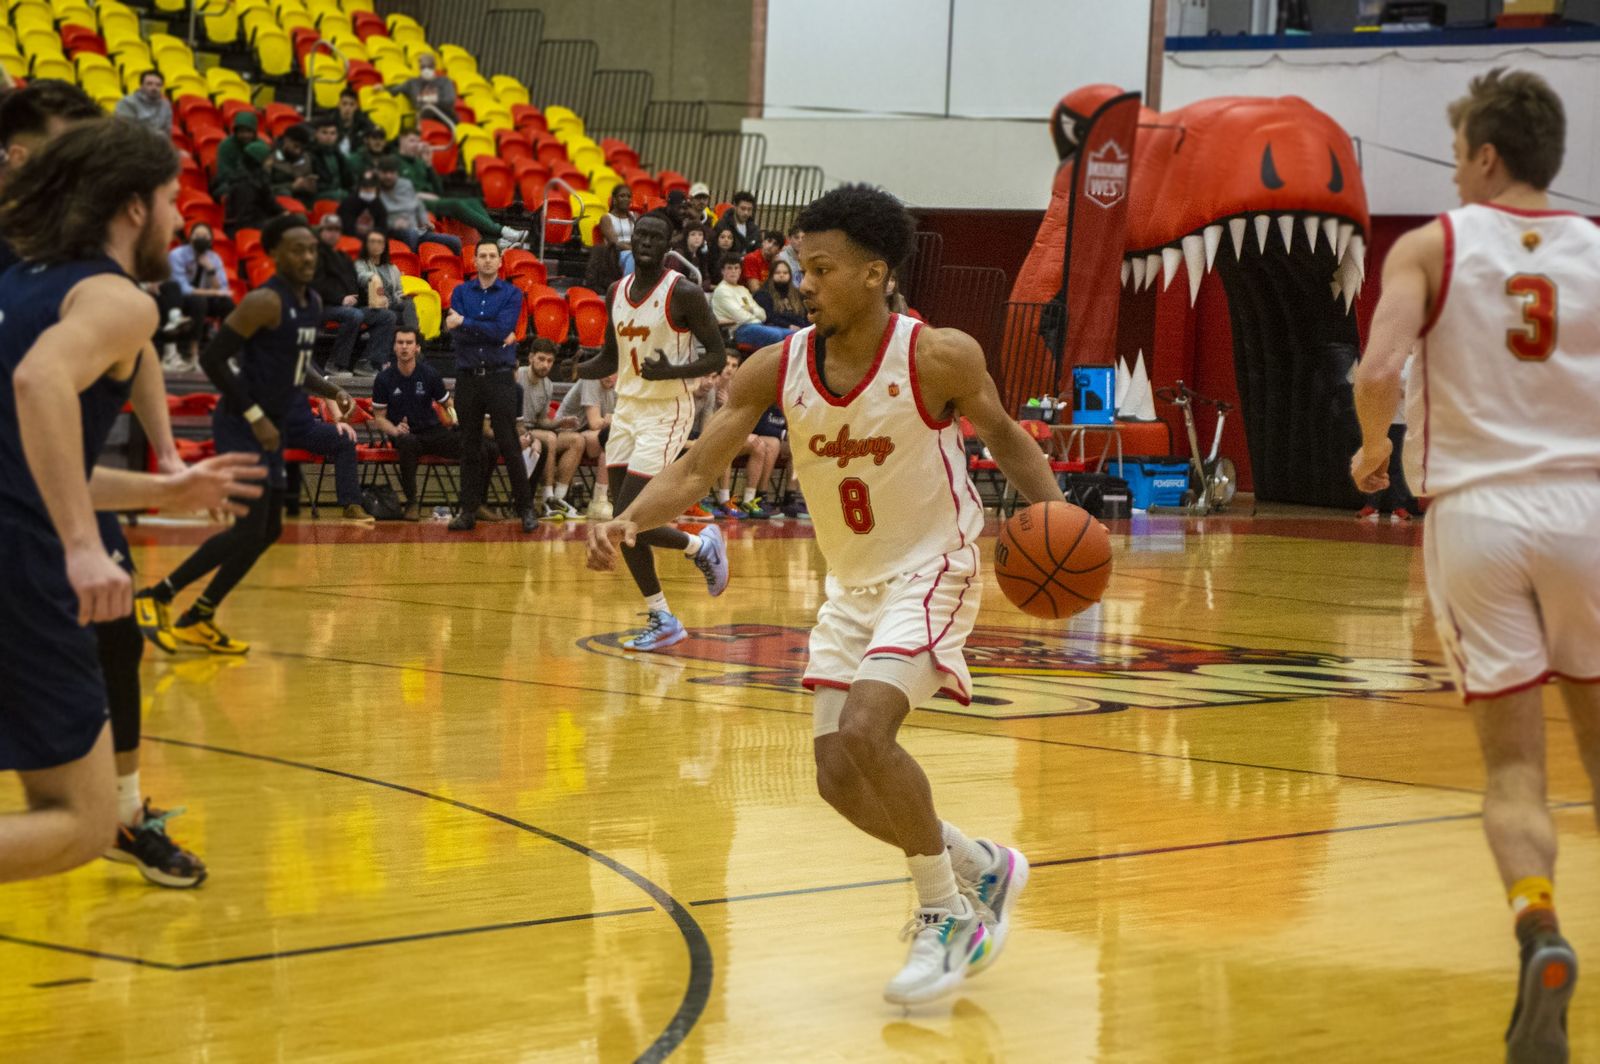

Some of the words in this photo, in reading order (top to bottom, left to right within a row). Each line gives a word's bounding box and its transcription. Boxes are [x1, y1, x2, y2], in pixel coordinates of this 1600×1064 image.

[1505, 272, 1558, 361] 3
[630, 347, 641, 376] 1
[808, 423, 896, 469] Calgary
[838, 476, 876, 535] 8
